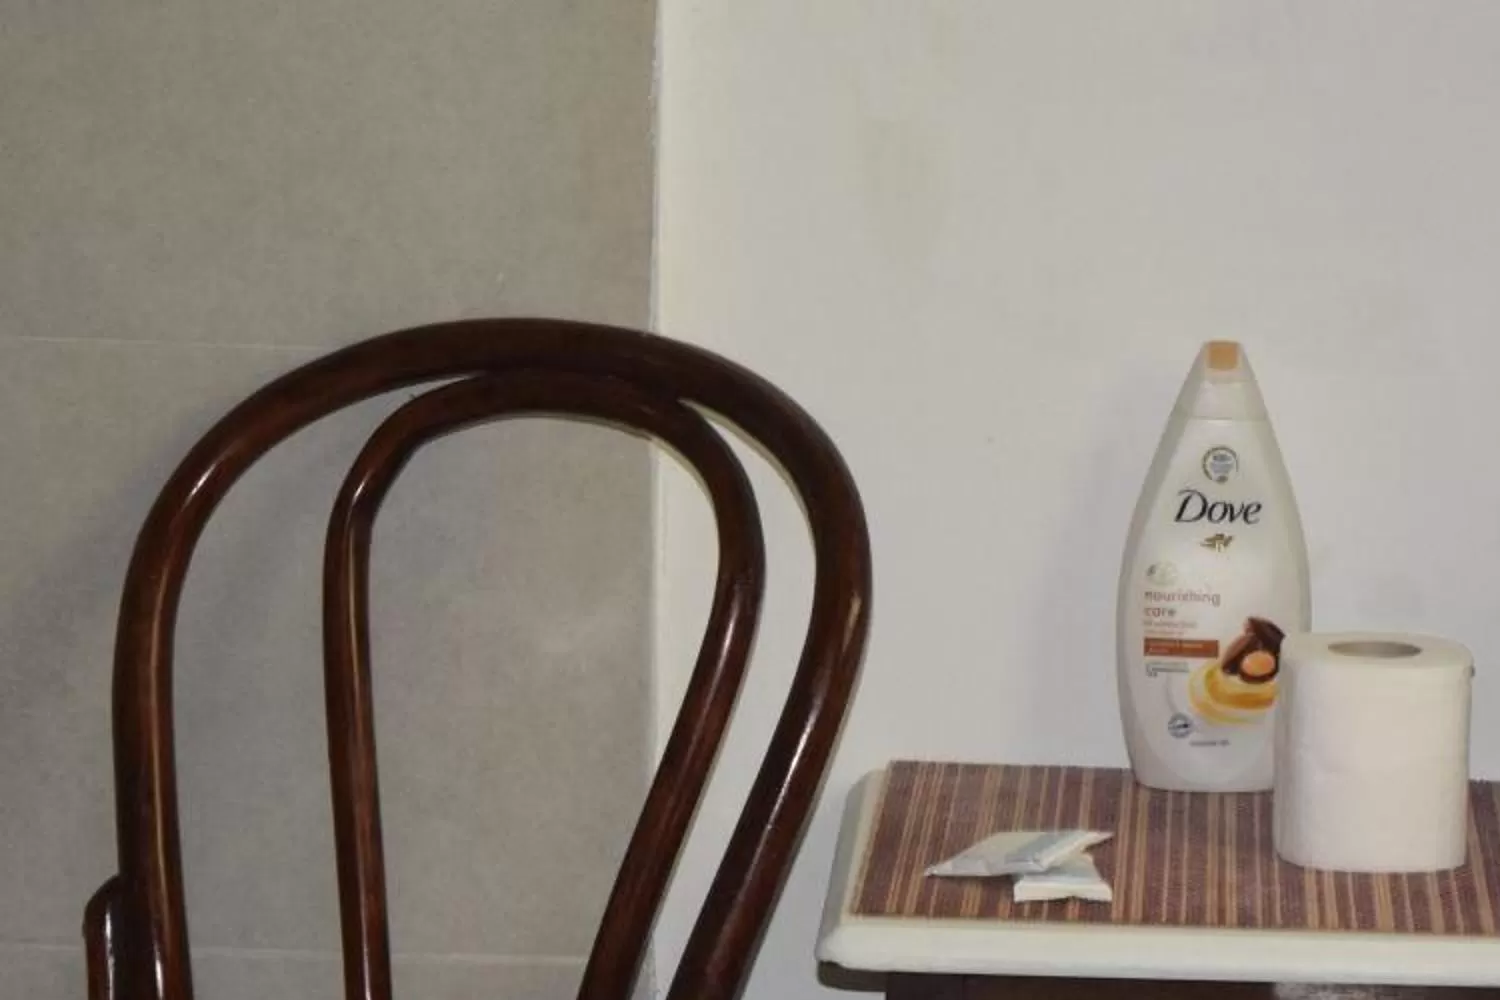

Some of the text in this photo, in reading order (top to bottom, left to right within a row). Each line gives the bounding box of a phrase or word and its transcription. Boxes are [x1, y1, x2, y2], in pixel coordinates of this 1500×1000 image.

[1174, 488, 1262, 525] Dove
[1144, 590, 1221, 607] nourishing
[1144, 606, 1177, 617] care
